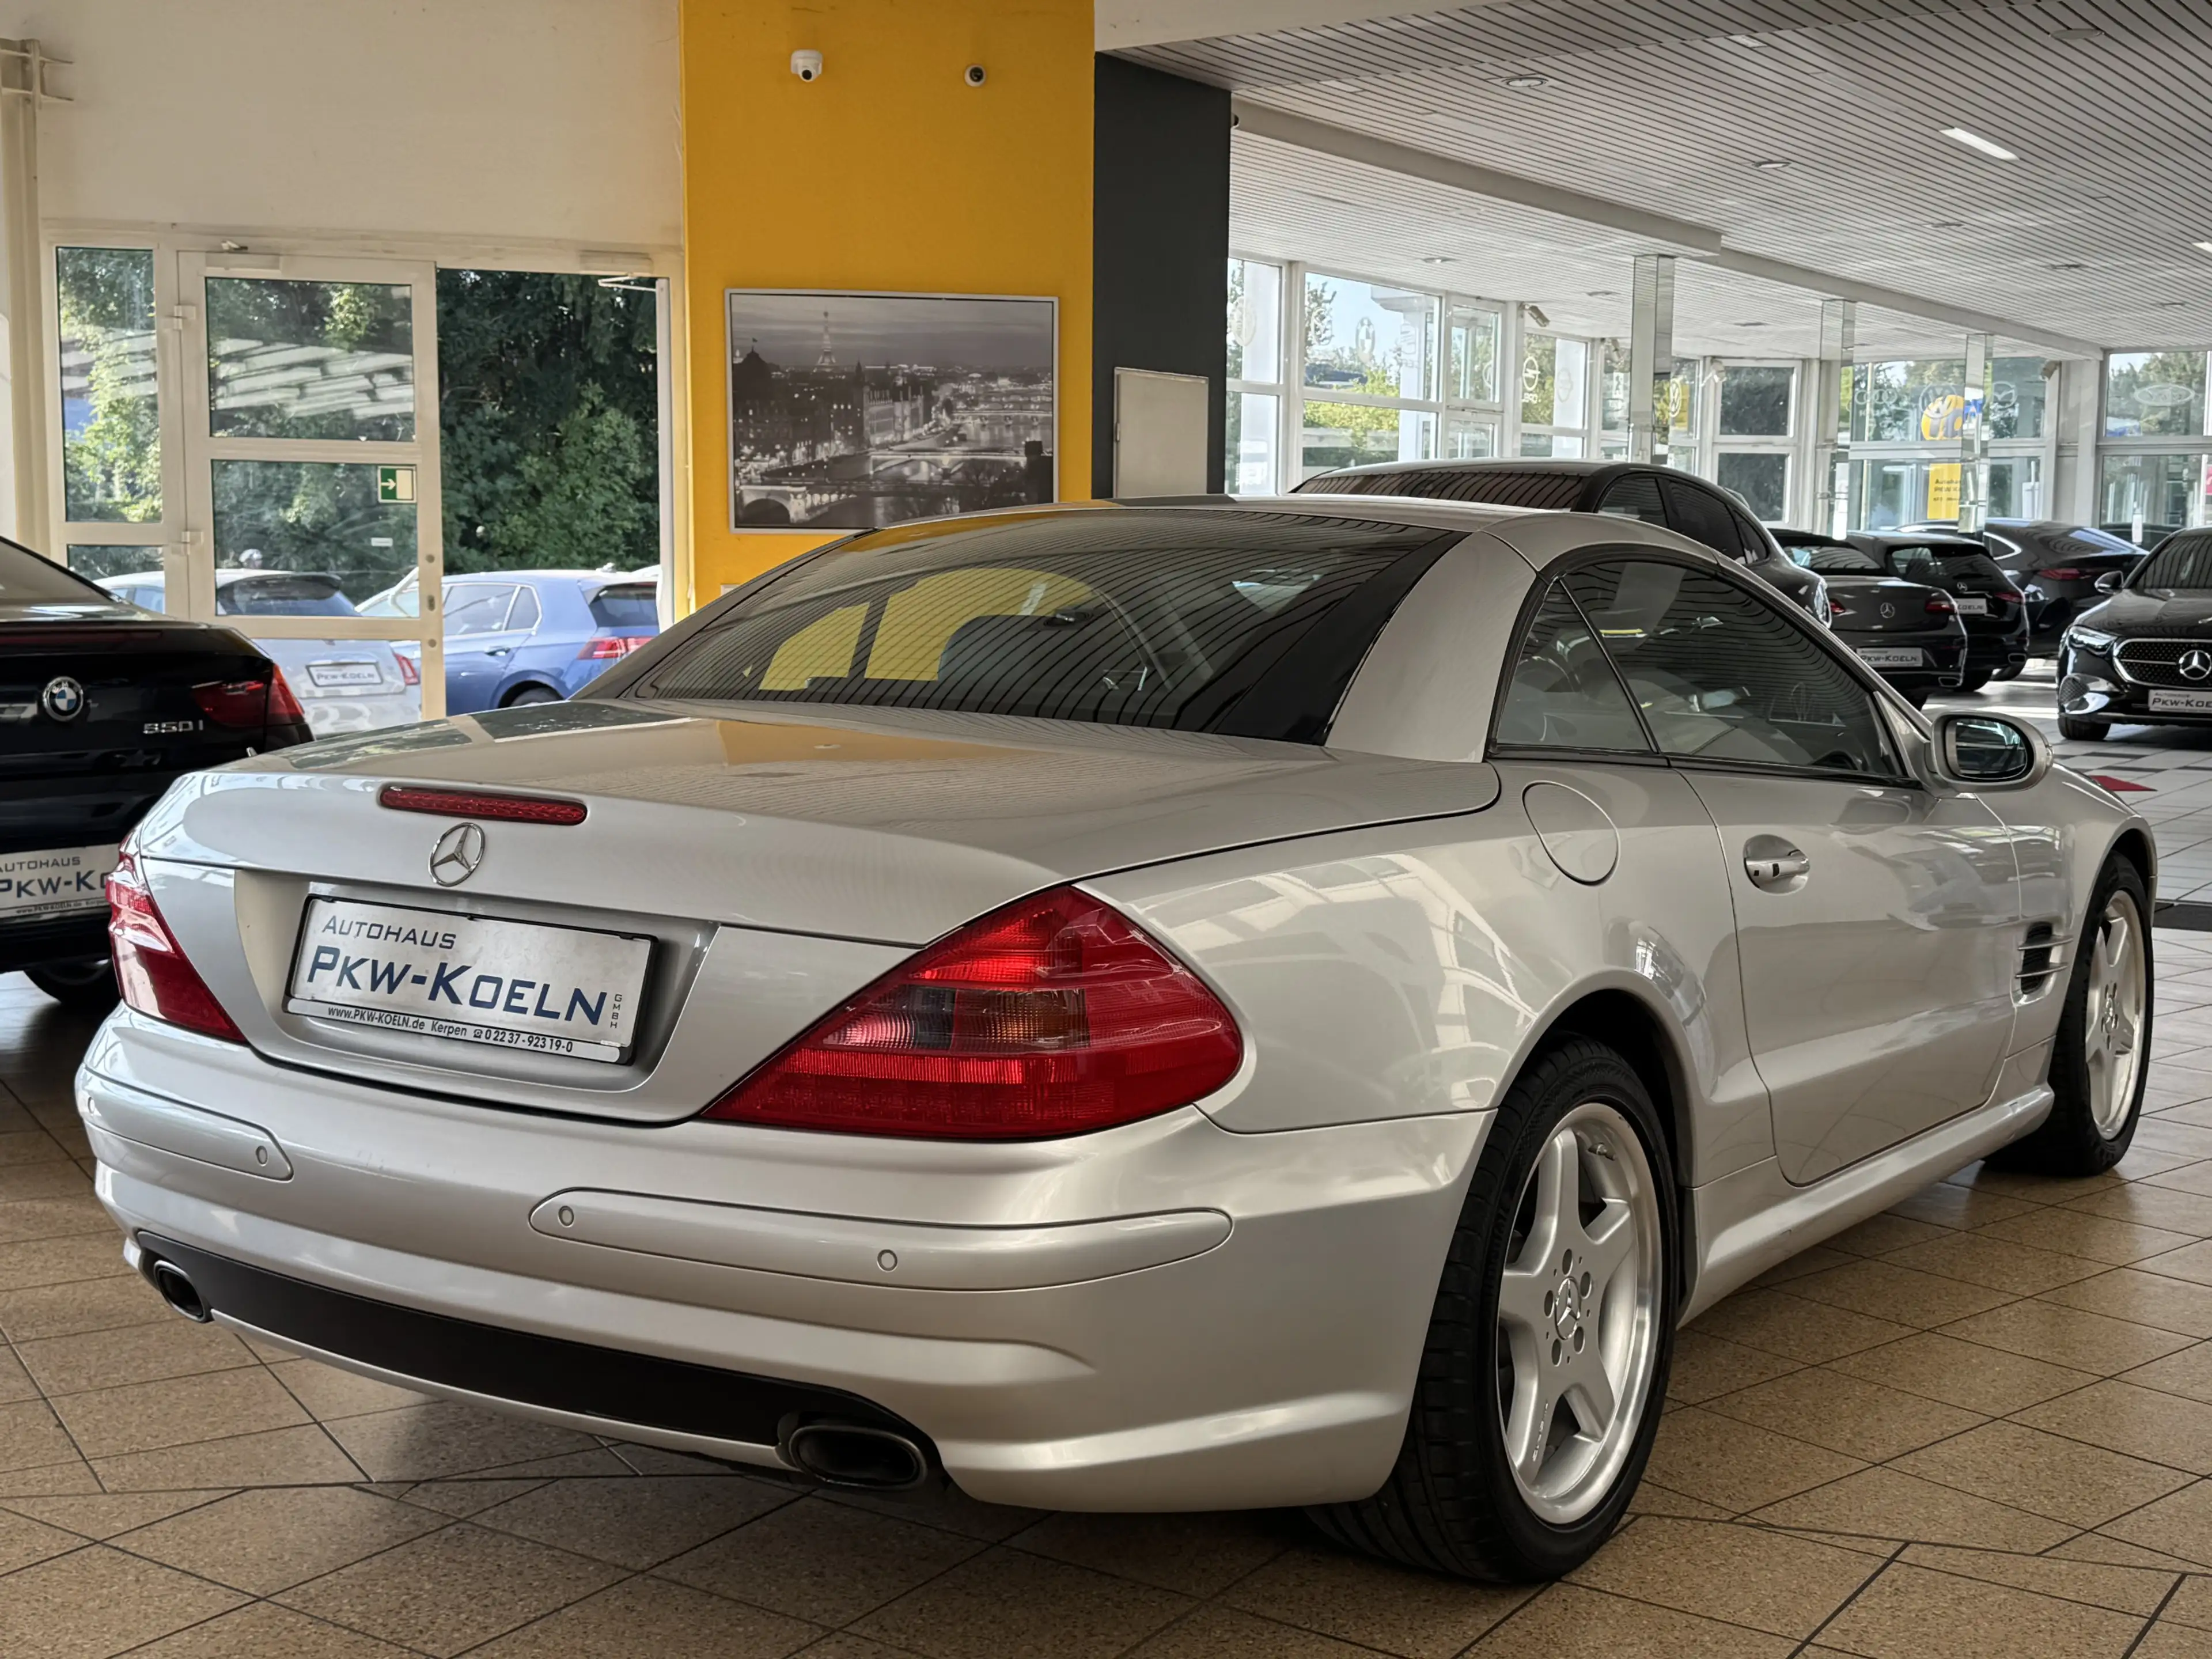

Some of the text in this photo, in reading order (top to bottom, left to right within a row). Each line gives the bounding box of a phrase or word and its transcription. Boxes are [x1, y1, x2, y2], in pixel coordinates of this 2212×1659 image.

[322, 915, 457, 949] AUTOHAUS
[307, 945, 608, 1025] PKW-KOELN
[328, 1006, 425, 1030] www.PKW-KOELN.de
[430, 1021, 467, 1036] Kerpen
